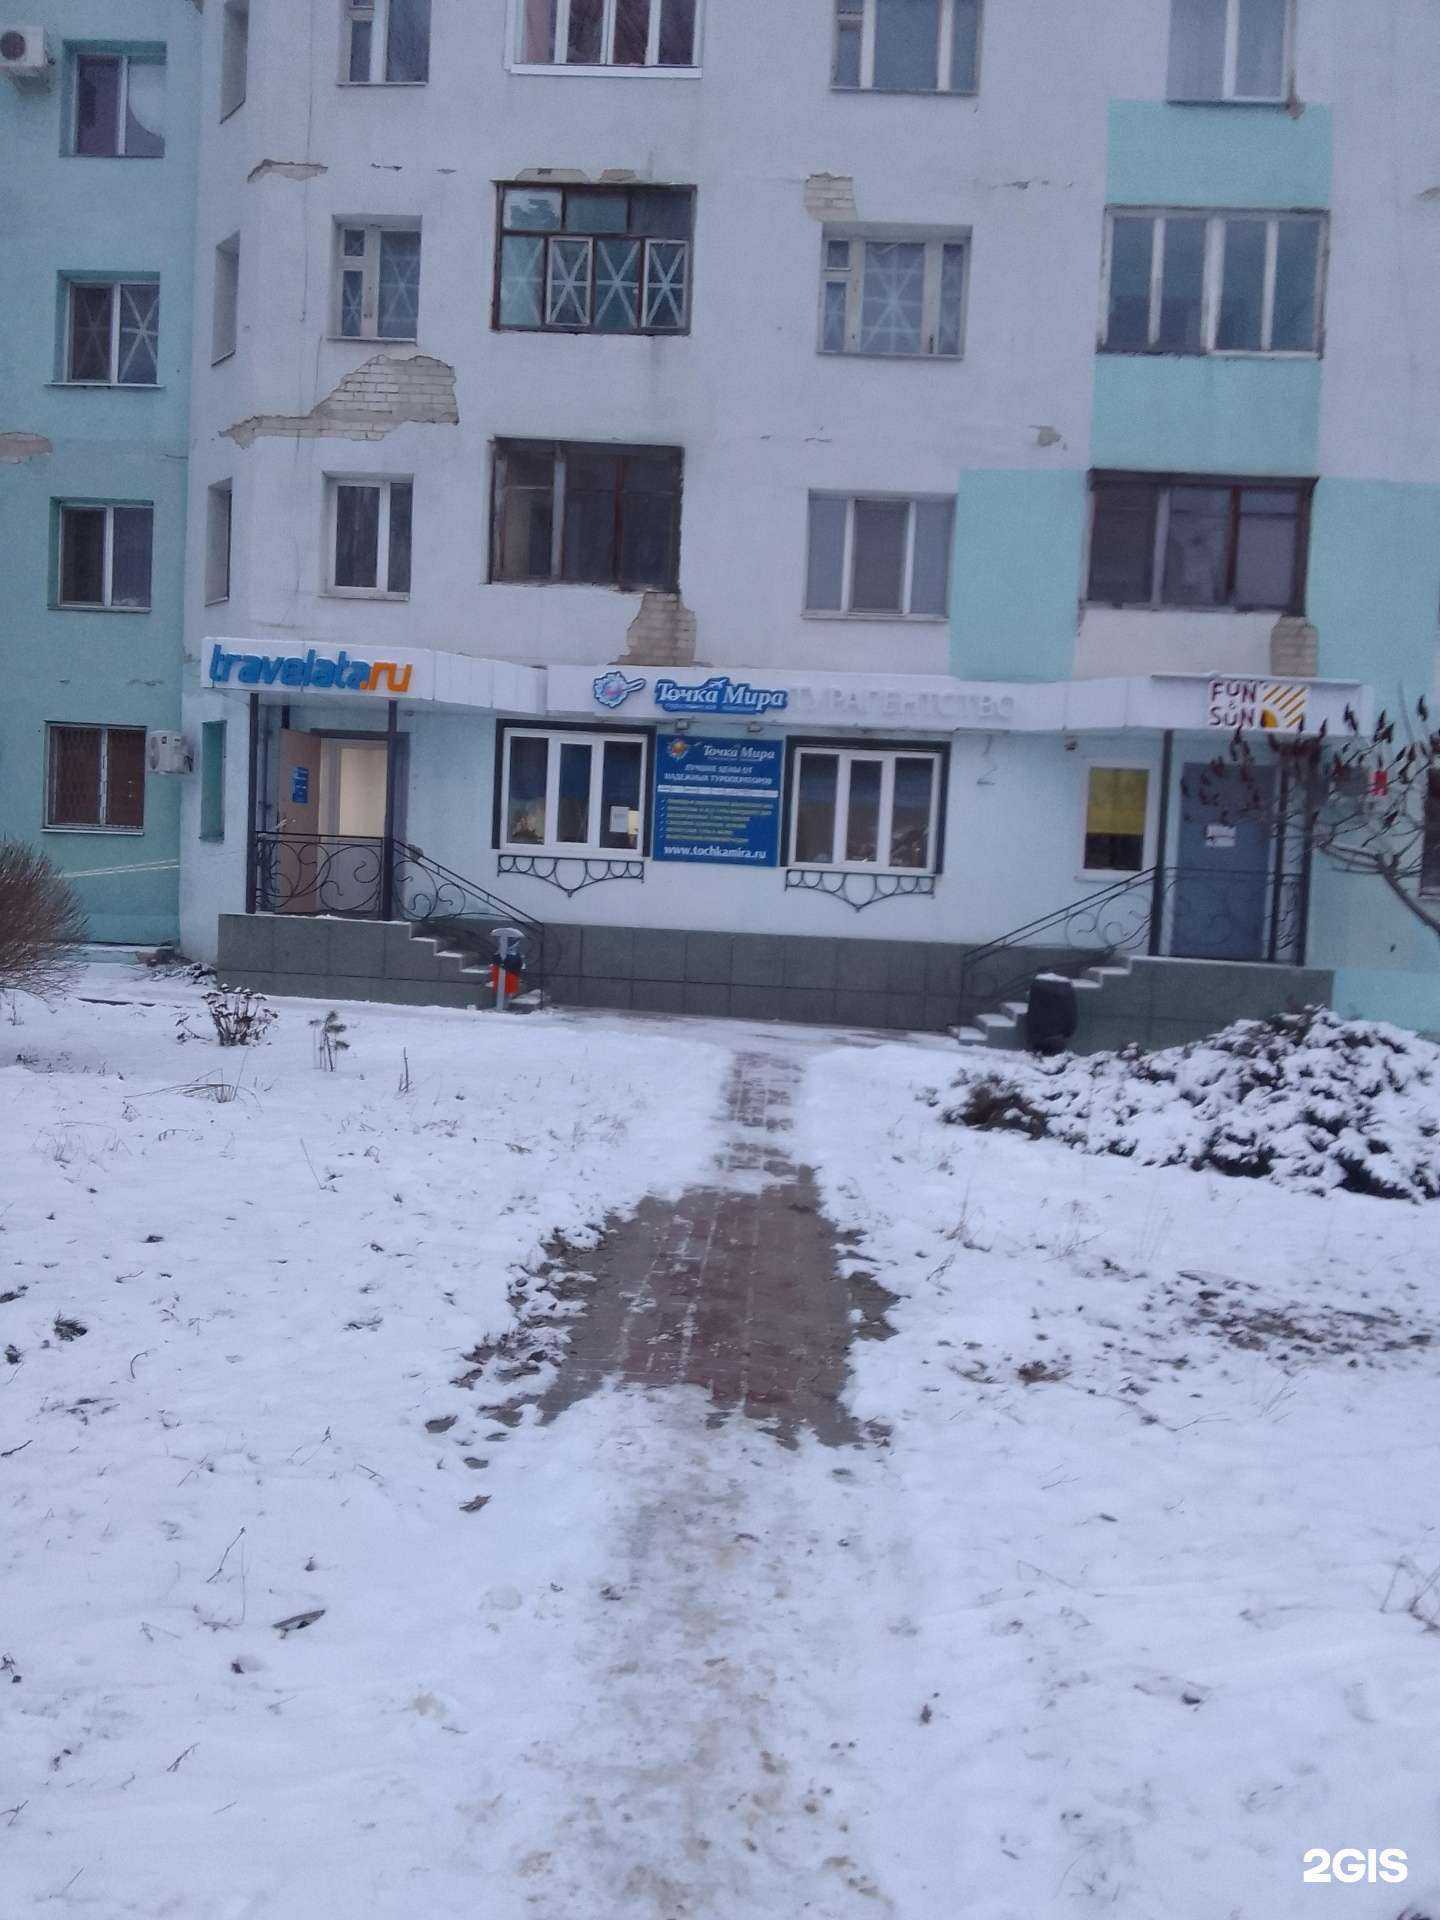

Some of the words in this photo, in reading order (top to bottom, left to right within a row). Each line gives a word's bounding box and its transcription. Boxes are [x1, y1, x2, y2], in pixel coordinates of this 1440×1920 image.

[209, 644, 413, 692] travelata.ru
[657, 682, 719, 704] Точка
[722, 685, 785, 711] Мира
[1210, 682, 1257, 703] FUN
[1209, 706, 1255, 728] SUN
[703, 745, 739, 758] Точка
[740, 746, 776, 761] Мира
[663, 845, 767, 859] www.tochkamira.ru
